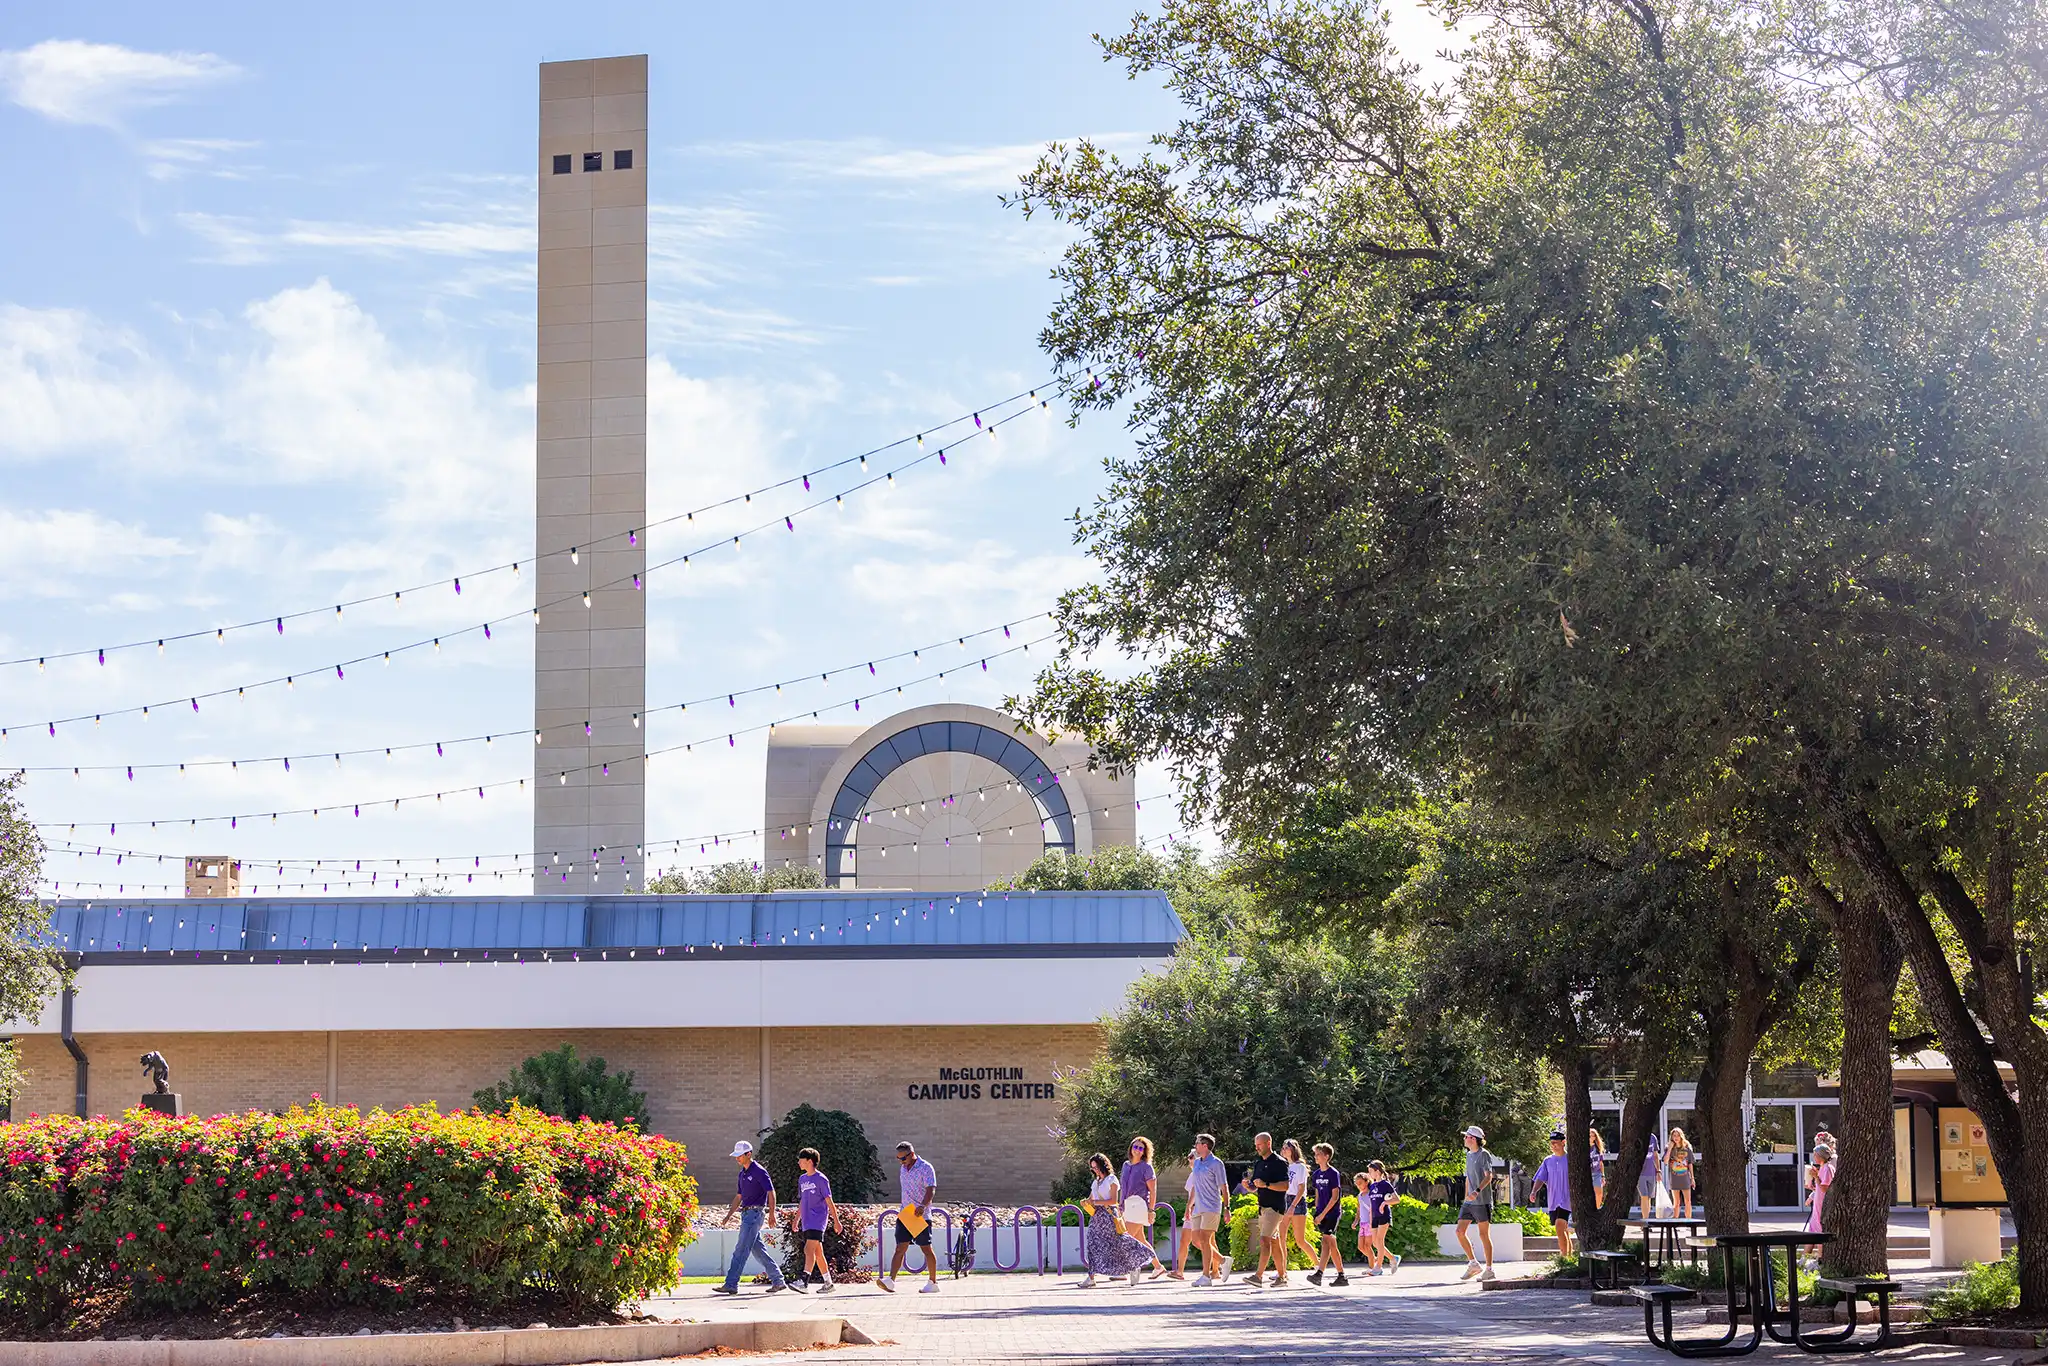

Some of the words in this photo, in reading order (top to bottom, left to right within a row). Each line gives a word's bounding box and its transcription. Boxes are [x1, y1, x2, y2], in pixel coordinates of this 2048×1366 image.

[939, 1067, 1023, 1081] McGLOTHLIN
[908, 1083, 981, 1100] CAMPUS
[990, 1083, 1055, 1100] CENTER
